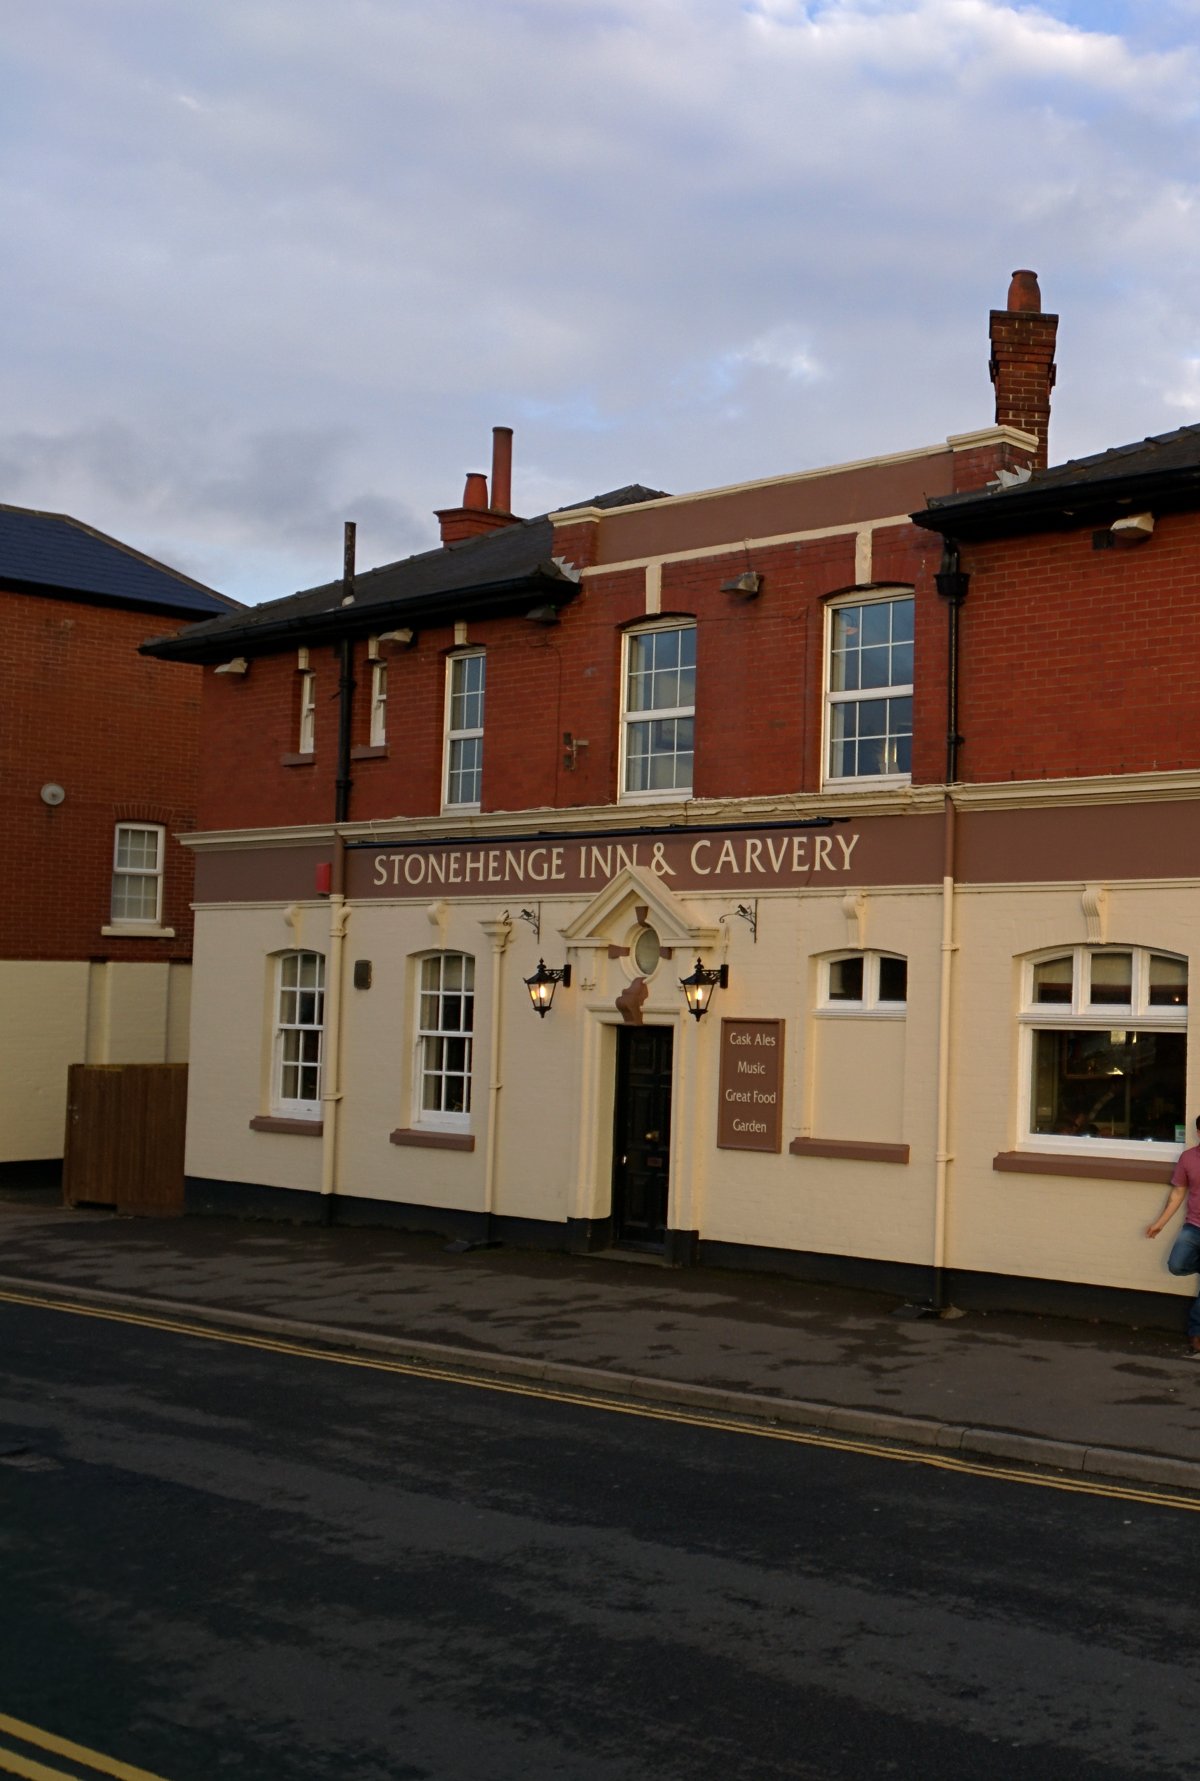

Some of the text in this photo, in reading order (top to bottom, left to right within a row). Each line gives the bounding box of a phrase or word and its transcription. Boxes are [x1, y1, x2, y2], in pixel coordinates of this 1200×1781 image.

[373, 833, 861, 887] STONEHENGE INN & CARVERY
[730, 1032, 776, 1047] Cask Ales
[737, 1061, 766, 1075] Music
[725, 1089, 777, 1104] Great Food
[732, 1118, 767, 1134] Garden
